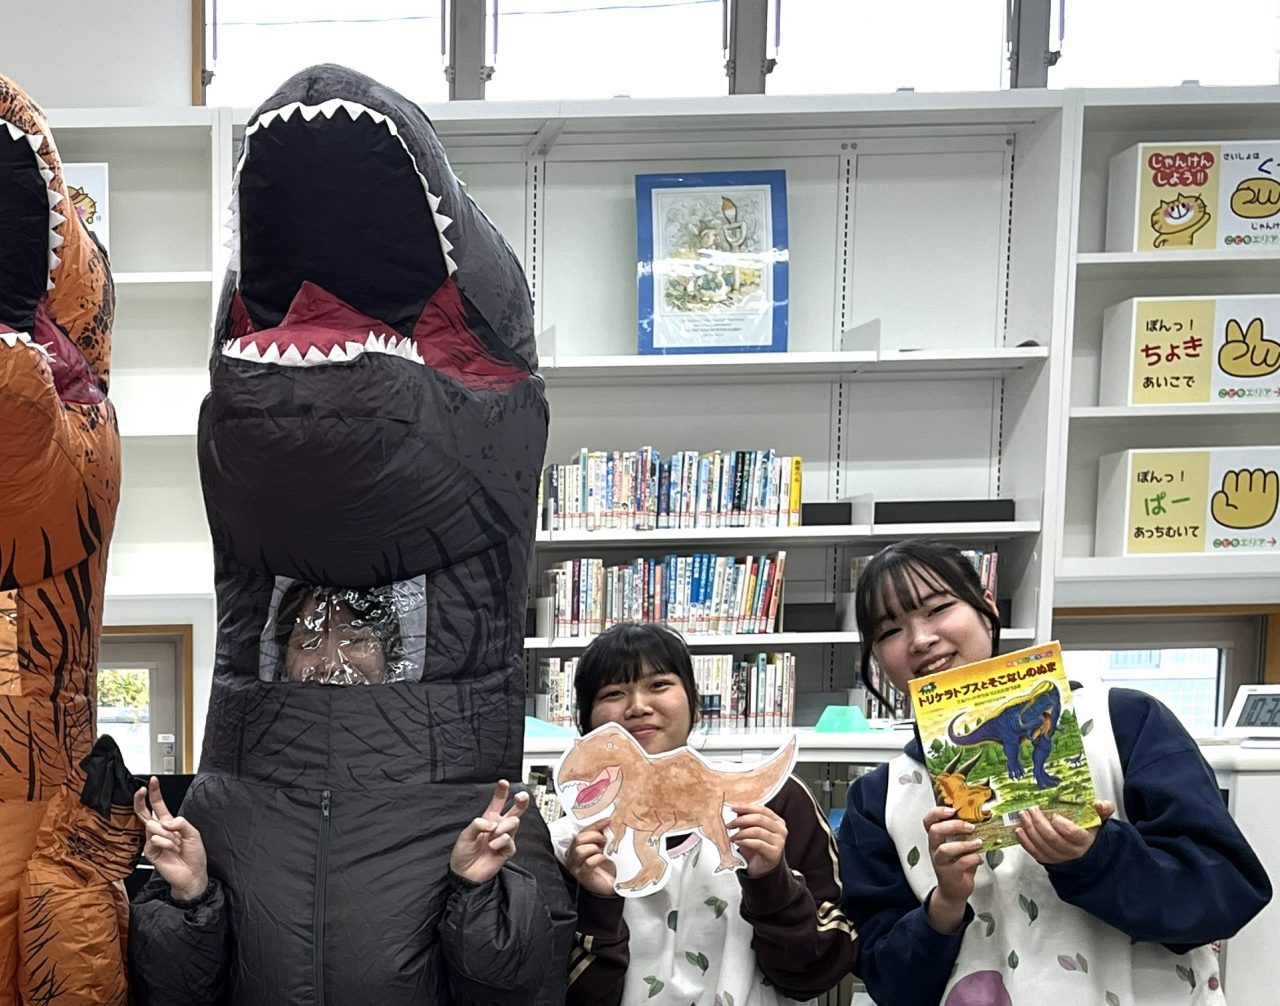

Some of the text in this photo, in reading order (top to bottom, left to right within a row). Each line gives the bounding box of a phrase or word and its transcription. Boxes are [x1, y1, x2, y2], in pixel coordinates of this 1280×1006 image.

[1152, 154, 1212, 168] じゃんけん
[1223, 152, 1260, 160] さいしょは
[1140, 335, 1203, 367] ちょき
[1142, 376, 1195, 389] あいこで
[1144, 491, 1191, 516] ぱー
[1133, 525, 1200, 539] あっちむいて
[918, 661, 1056, 707] トリケラトプスとそこなしのぬま
